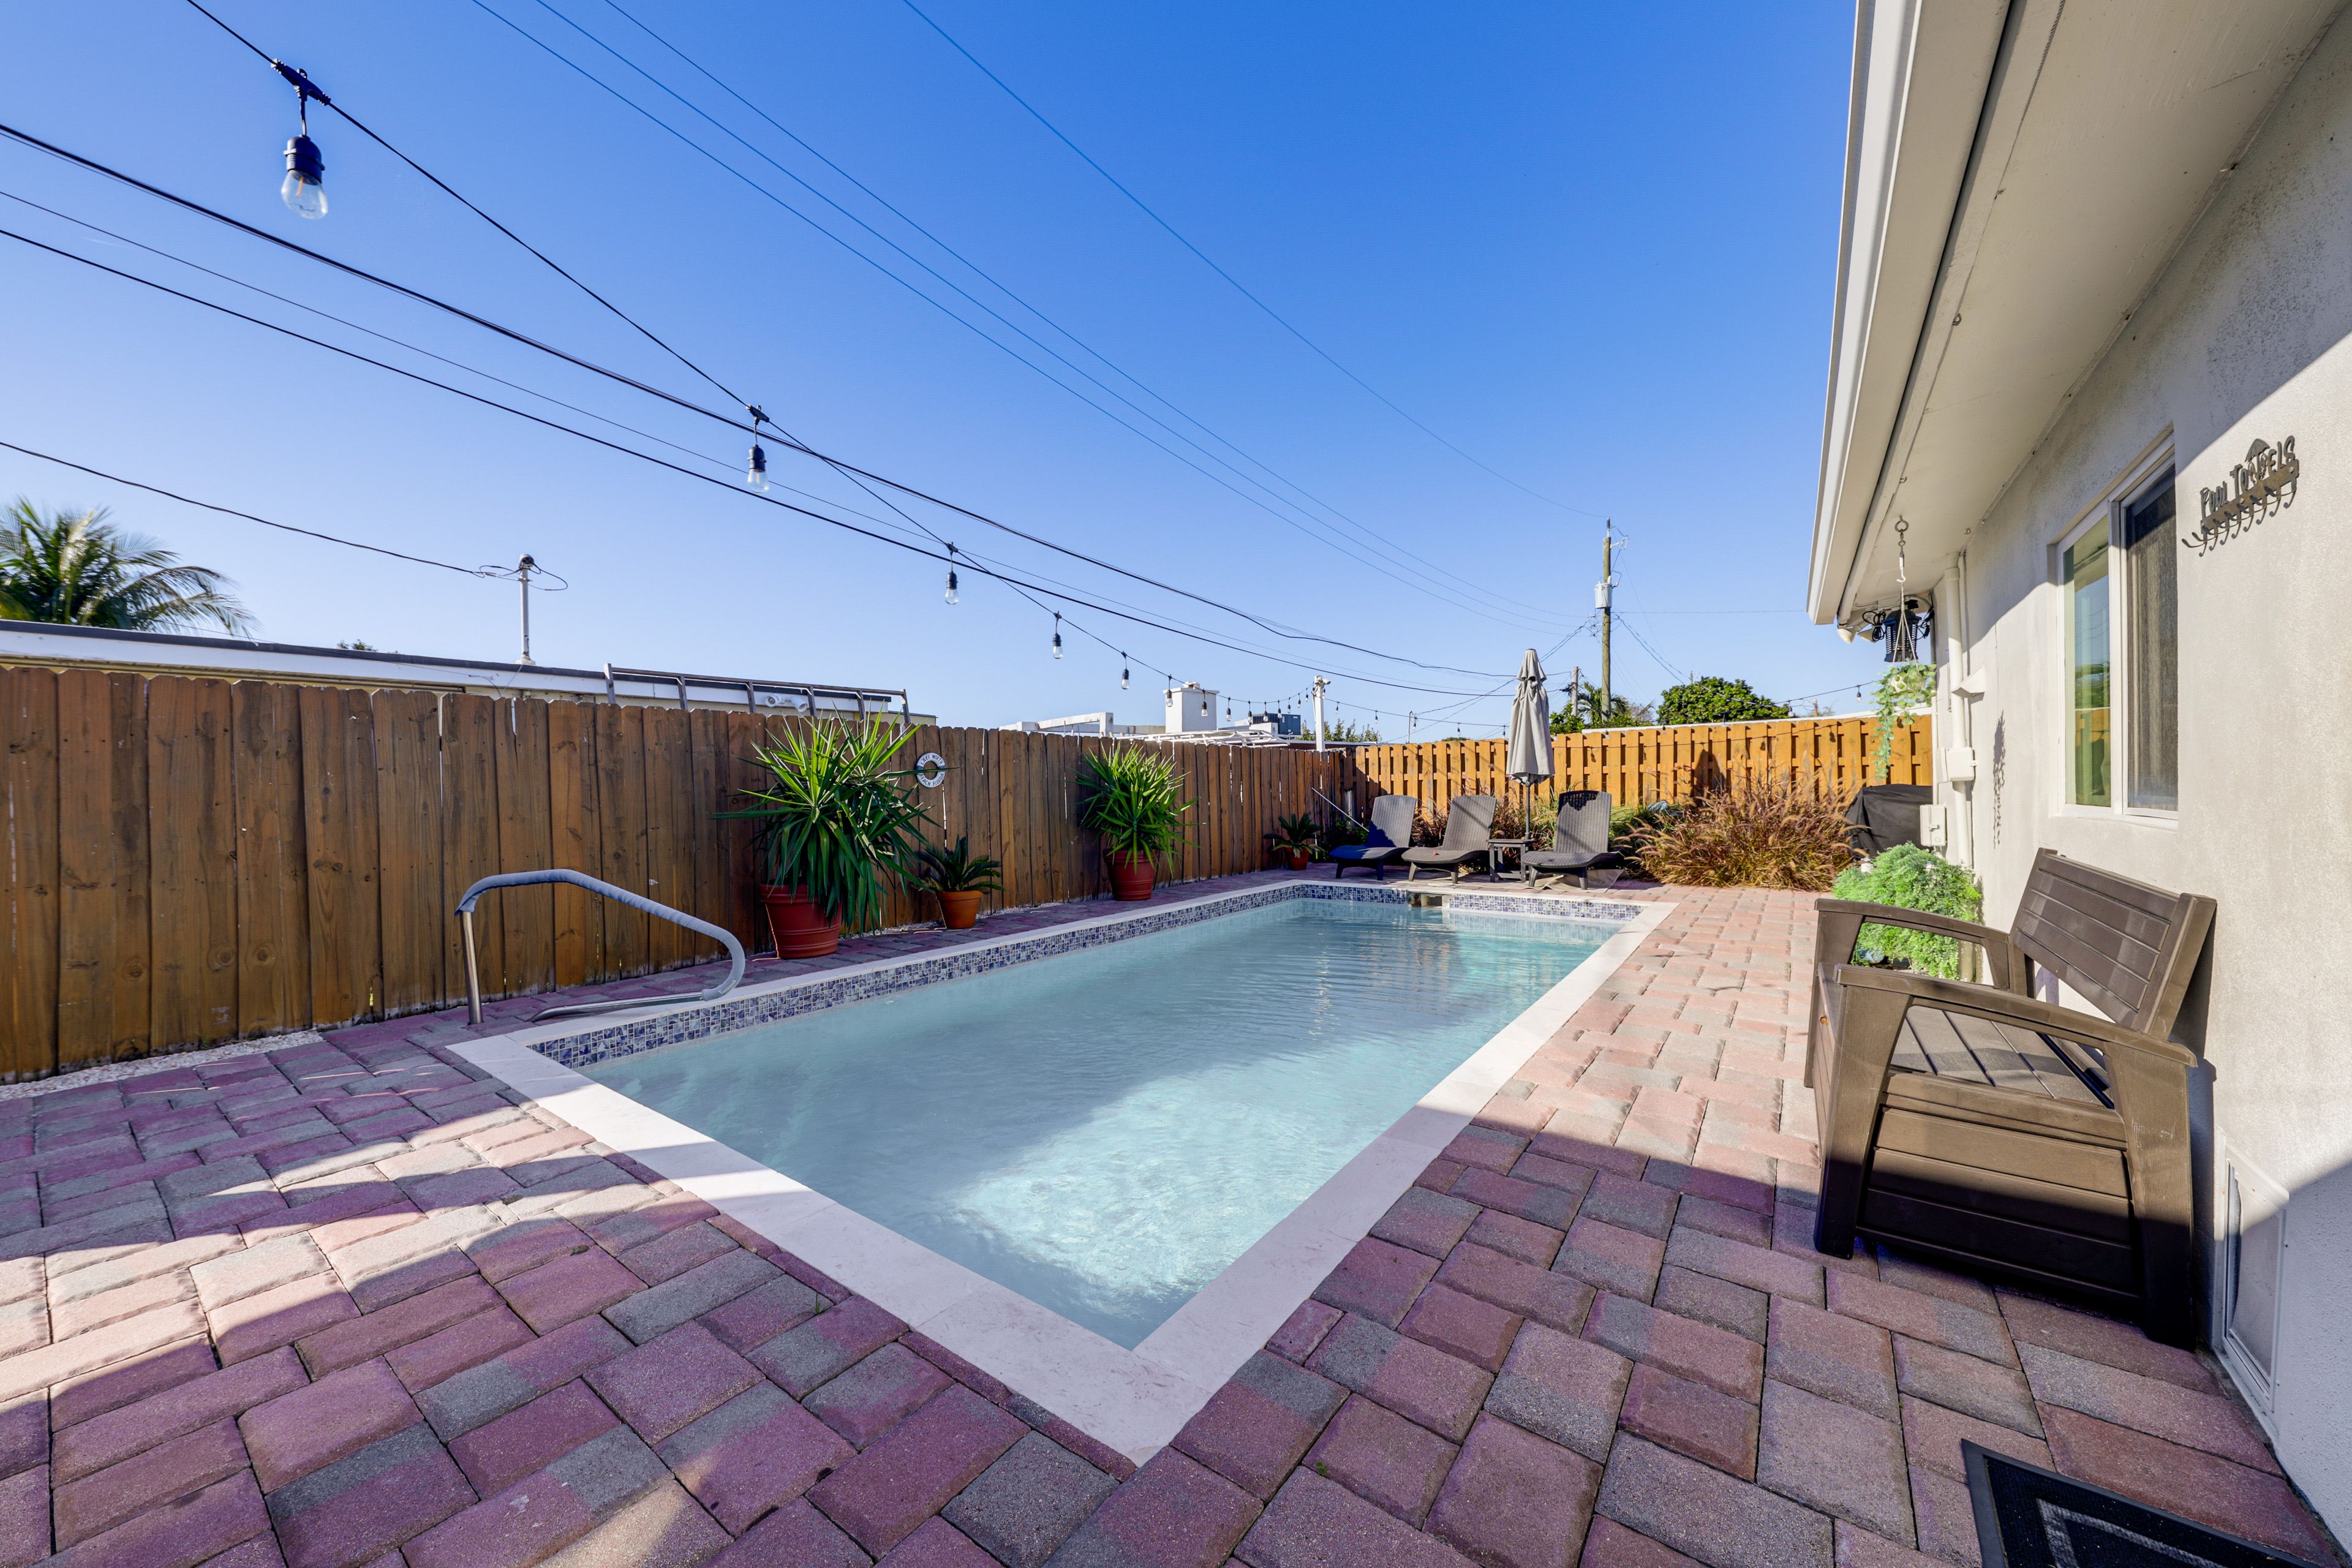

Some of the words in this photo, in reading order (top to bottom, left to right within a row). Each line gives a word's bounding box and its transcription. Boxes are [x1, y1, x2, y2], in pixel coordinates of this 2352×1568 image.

[920, 754, 930, 765] LAKE
[932, 754, 943, 765] WORTH
[920, 774, 931, 786] BEACH
[932, 774, 944, 786] FLORIDA
